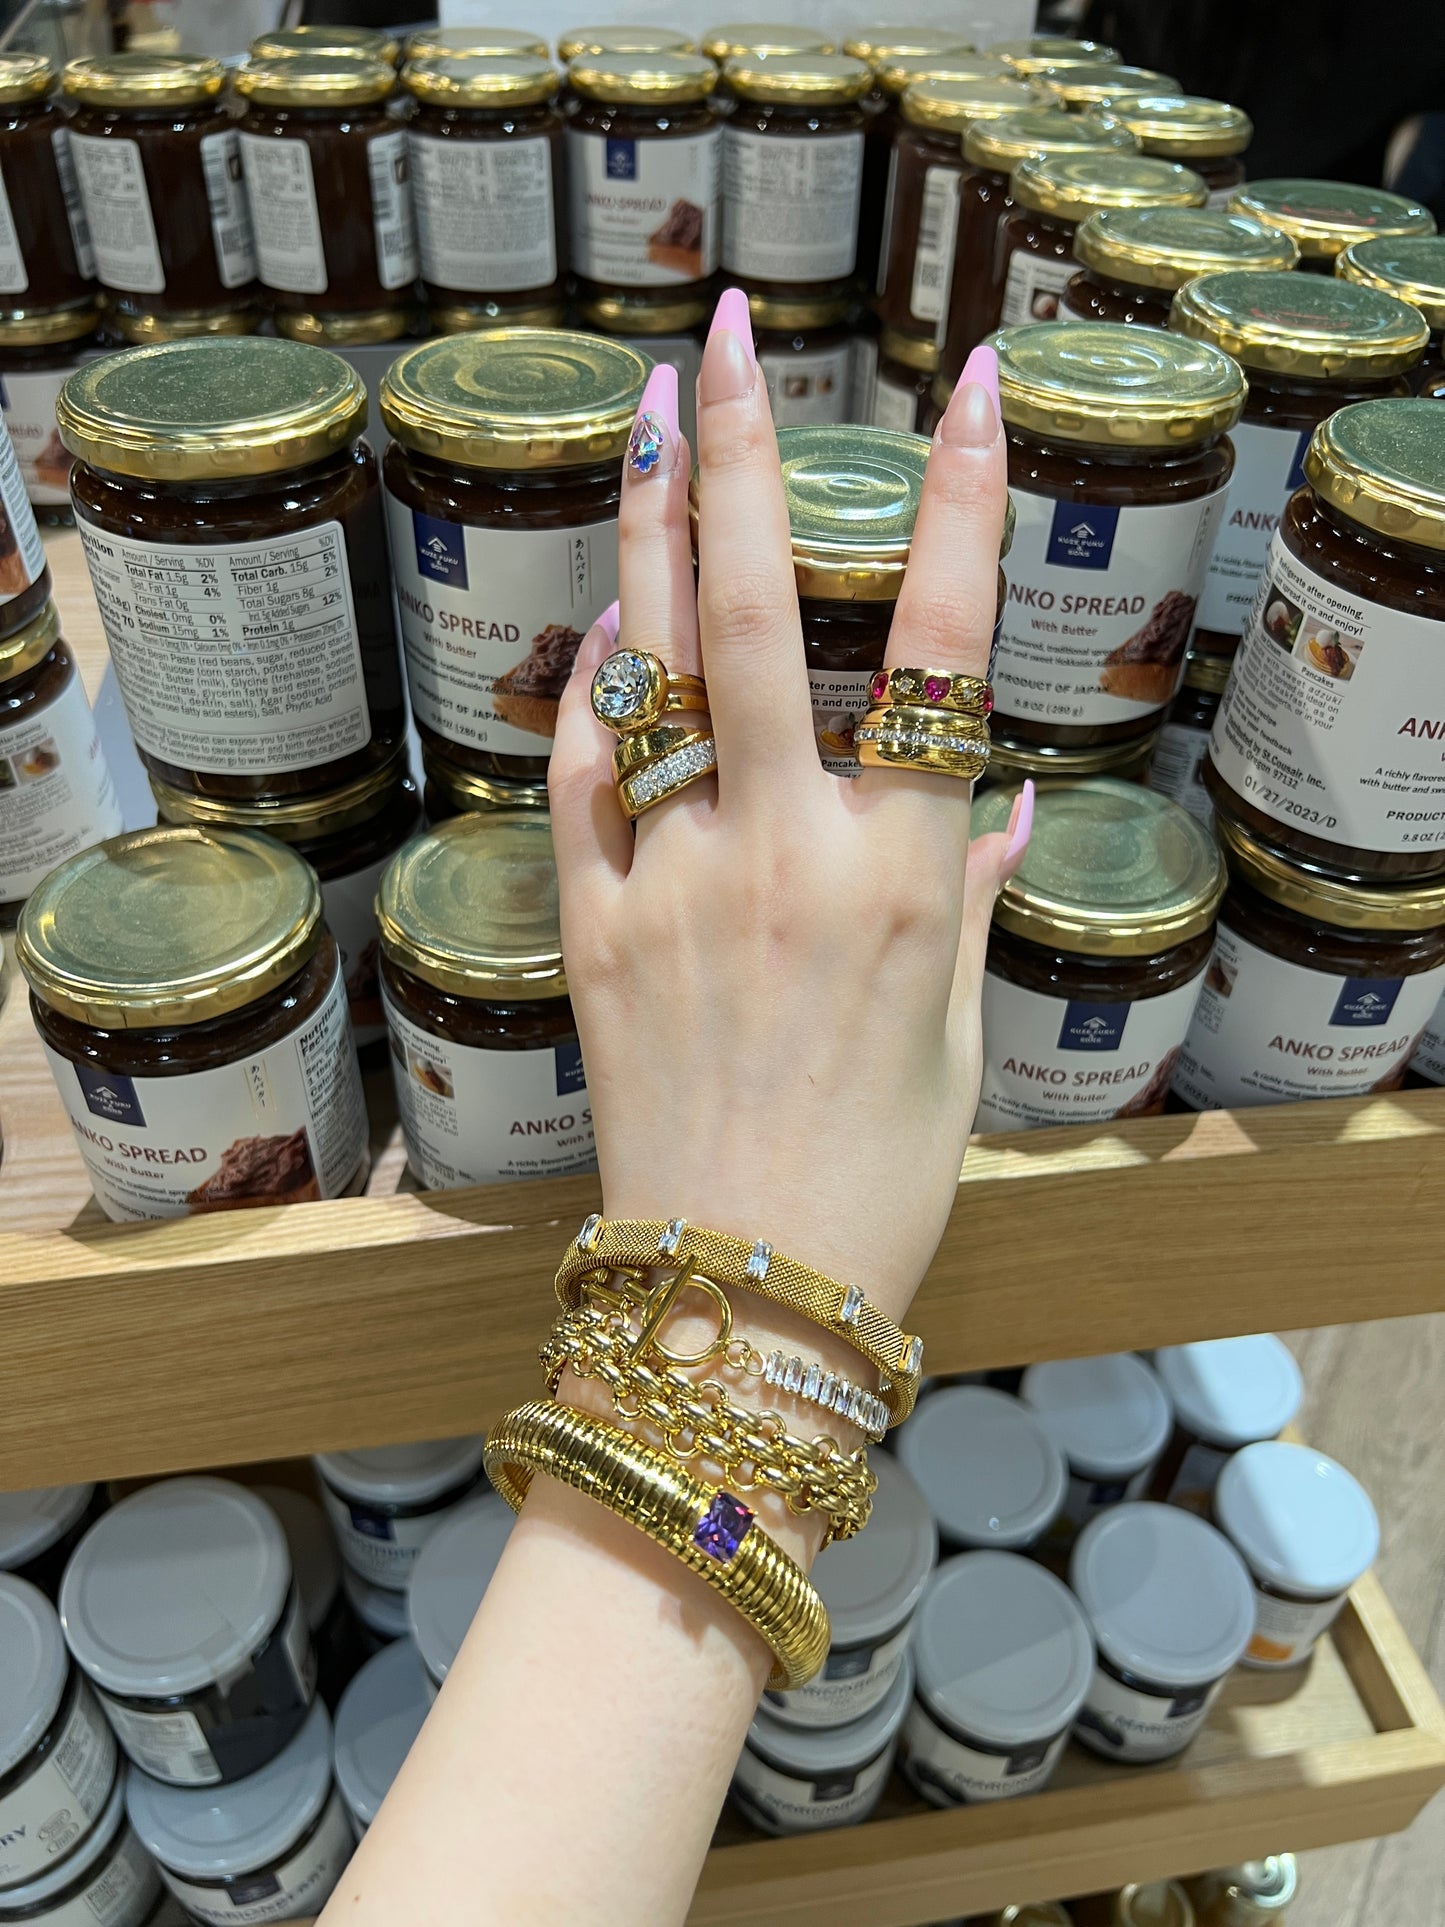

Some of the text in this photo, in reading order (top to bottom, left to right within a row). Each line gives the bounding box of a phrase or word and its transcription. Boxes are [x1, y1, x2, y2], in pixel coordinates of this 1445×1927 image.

[122, 549, 215, 570] Amount Serving %DV
[229, 547, 299, 567] Amount Serving
[231, 550, 336, 583] Total Carb. 15g 5%
[125, 564, 218, 585] Total Fat 1.5g 2%
[238, 564, 338, 596] Fiber 1g 2%
[130, 578, 221, 598] Sat. Fat 1g 4%
[240, 587, 315, 609] Total Sugars 8g
[323, 591, 342, 606] 12%
[135, 593, 189, 612] Trans Fat 0g
[1008, 583, 1146, 617] NKO SPREAD
[1282, 583, 1364, 636] spread it on and enjoy!
[1306, 585, 1326, 602] after
[1326, 596, 1364, 621] opening.
[122, 615, 135, 629] 70
[135, 605, 227, 626] Cholest. 0mg 0%
[138, 617, 170, 634] Sodium
[212, 628, 229, 638] 1%
[242, 620, 295, 636] Protein 1g
[439, 610, 521, 643] SPREAD
[1031, 618, 1098, 637] With Butter
[148, 631, 352, 668] Bean Paste (red beans, sugar, reduced starch
[159, 662, 195, 675] Glucose
[225, 667, 261, 678] starch,
[263, 661, 296, 675] potato
[297, 653, 329, 667] starch,
[330, 642, 354, 656] sweet
[446, 642, 477, 659] Butter
[166, 673, 194, 684] Butter
[231, 677, 269, 688] Glycine
[325, 653, 356, 670] sodium
[1301, 666, 1335, 690] Pancakes
[202, 687, 242, 699] glycerin
[244, 687, 269, 698] fatty
[272, 683, 293, 695] acid
[326, 664, 357, 682] sodium
[828, 683, 866, 693] openin
[997, 671, 1052, 691] PRODUCT
[1055, 684, 1071, 694] OF
[202, 708, 222, 718] acid
[315, 694, 333, 706] Acid
[260, 695, 284, 708] Agar
[286, 684, 327, 703] (sodium
[822, 698, 869, 709] and enjo
[1308, 686, 1343, 707] adzuki
[456, 703, 470, 714] OF
[472, 707, 510, 722] JAPAN
[1328, 704, 1340, 716] on
[822, 759, 859, 768] Pancake
[1273, 770, 1298, 790] 97132
[1375, 767, 1410, 782] A richly
[1359, 777, 1430, 795] with butter and
[1244, 775, 1338, 829] 01/27/2023/D
[1401, 832, 1435, 843] 9.8 OZ
[302, 1026, 329, 1057] Facts
[1268, 1034, 1334, 1061] ANKO
[1337, 1034, 1410, 1062] SPREAD
[1002, 1057, 1151, 1087] ANKO SPREAD
[1307, 1066, 1334, 1077] With
[1042, 1090, 1107, 1103] With Butter
[510, 1115, 576, 1136] ANKO
[557, 1135, 585, 1148] With
[118, 1142, 208, 1165] SPREAD
[104, 1156, 165, 1179] With Butter
